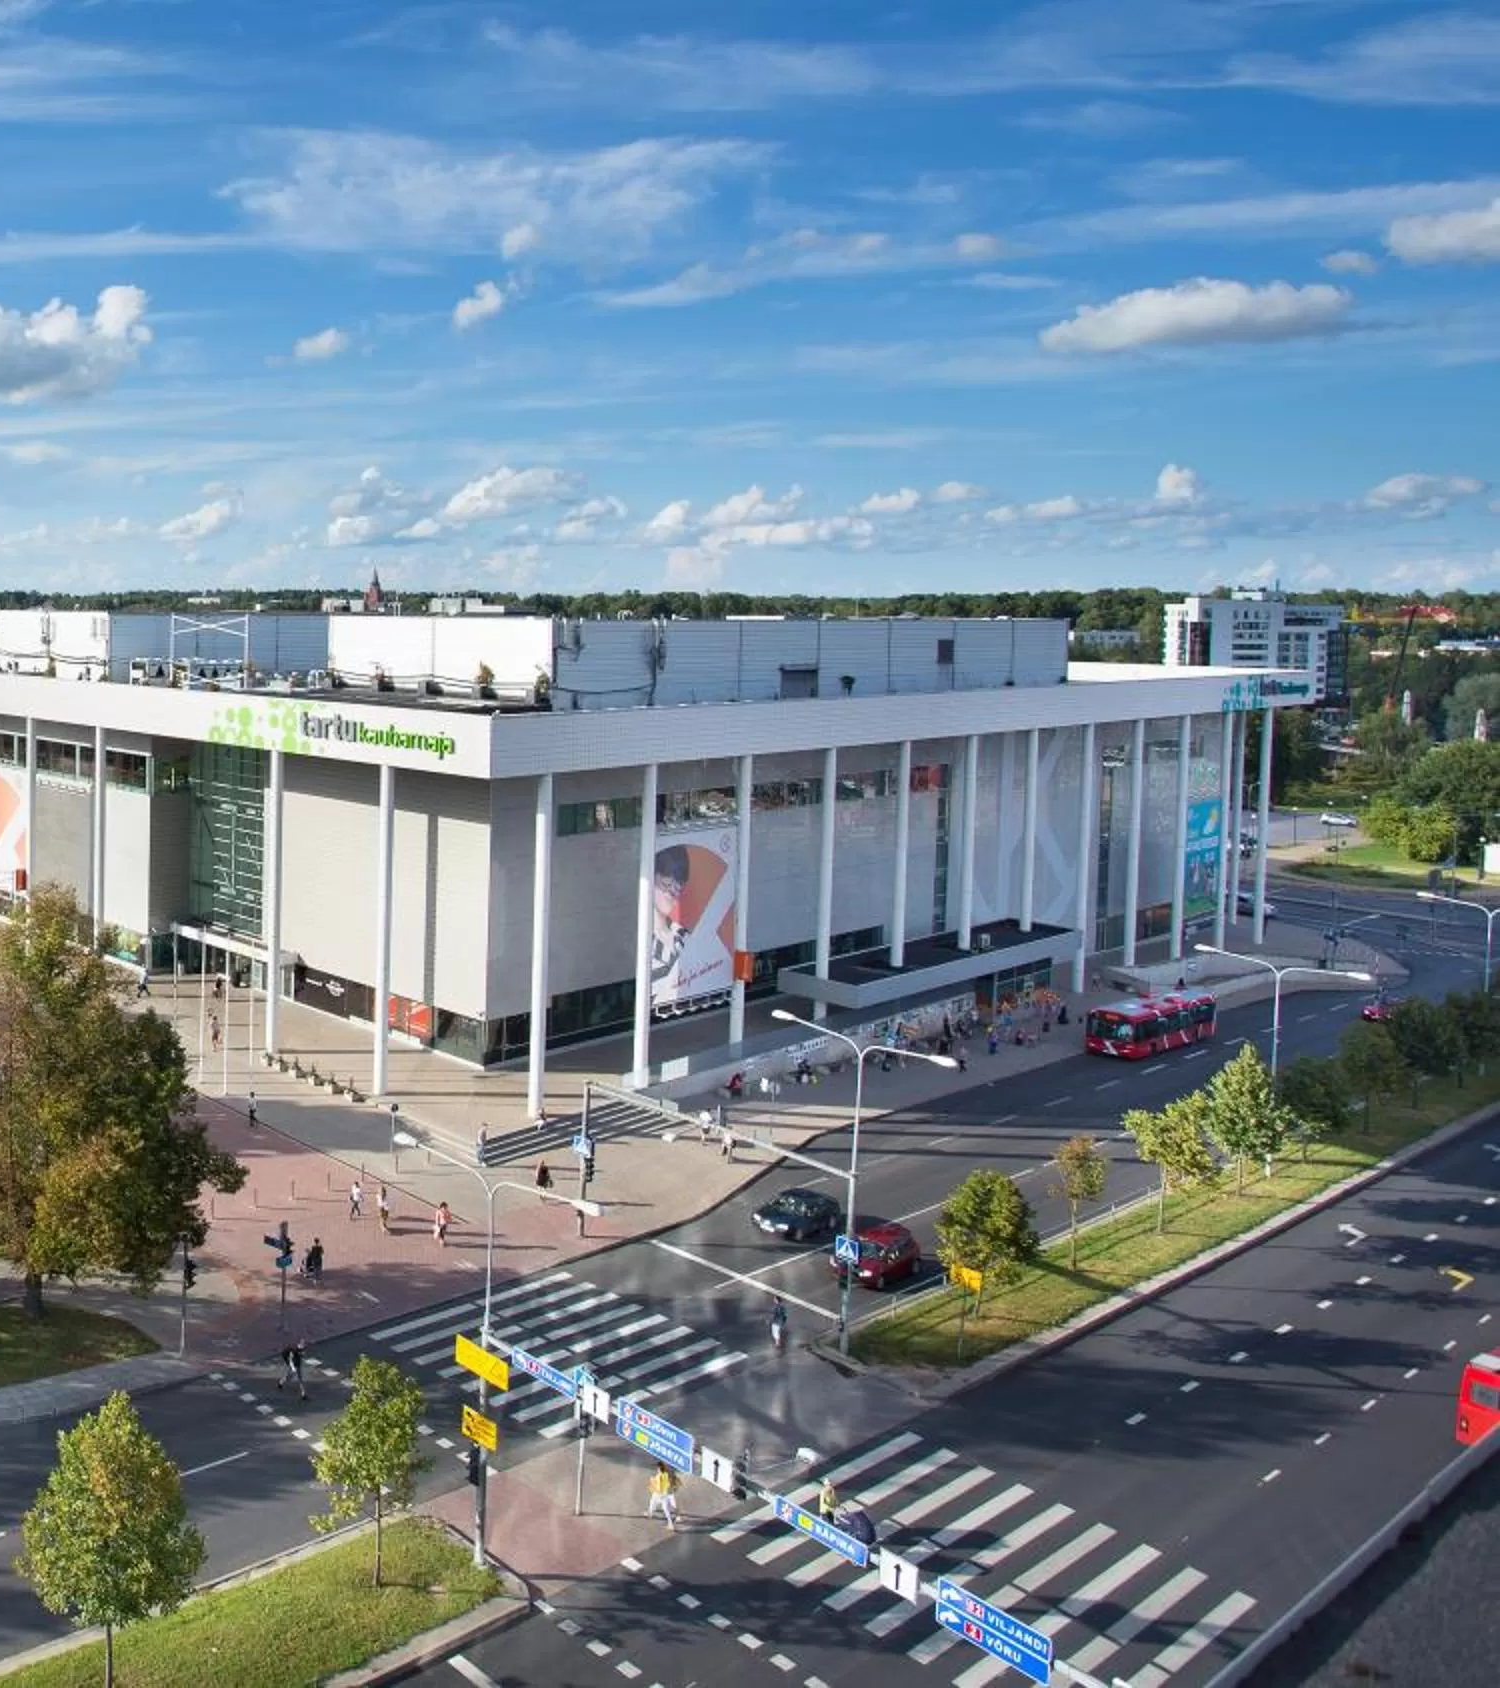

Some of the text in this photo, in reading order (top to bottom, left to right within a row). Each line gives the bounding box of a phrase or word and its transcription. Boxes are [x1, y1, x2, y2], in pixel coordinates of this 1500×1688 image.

[300, 711, 456, 759] tartu kaubamaja
[987, 1611, 1047, 1655] VILJANDI
